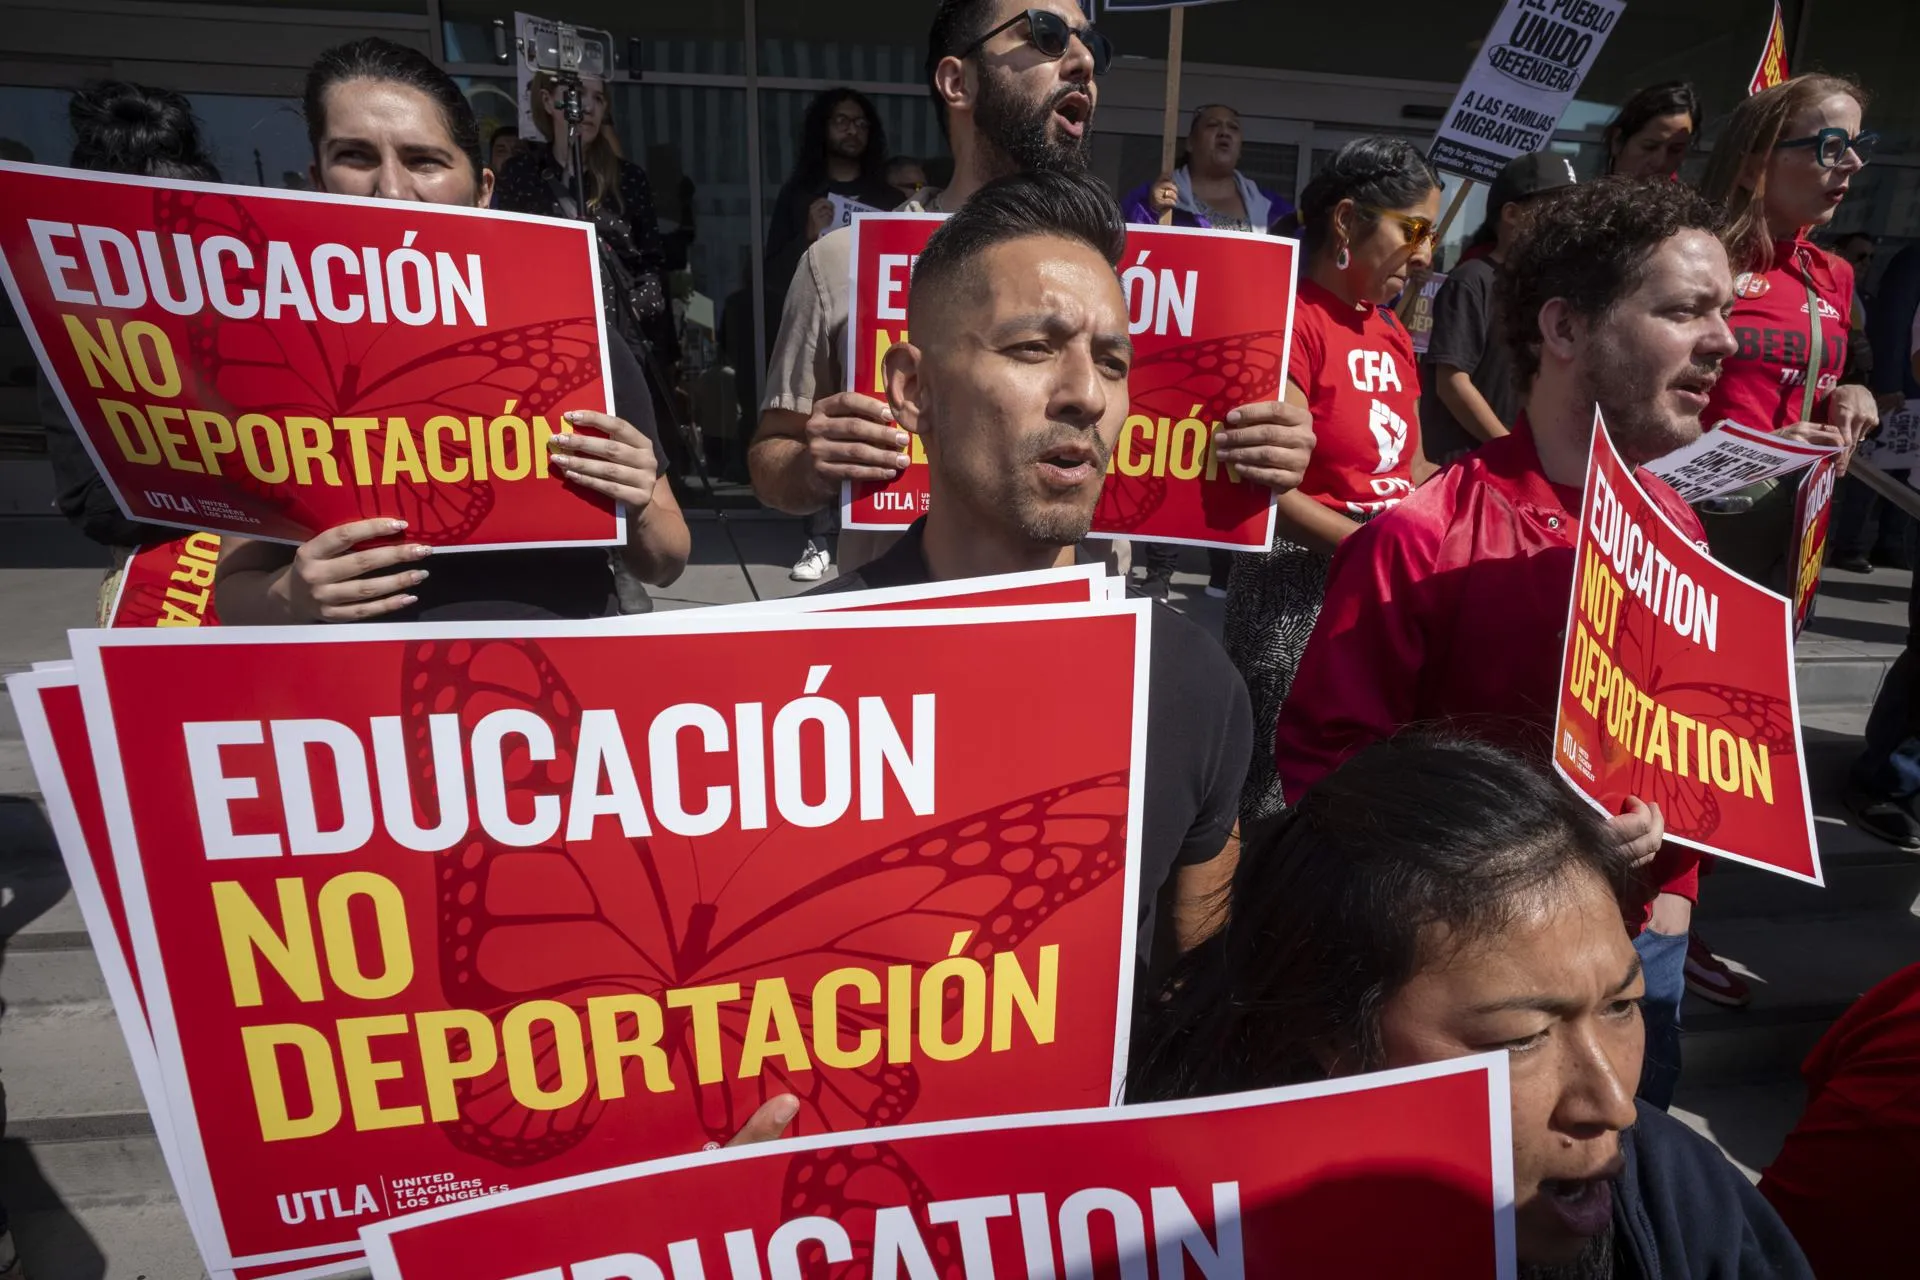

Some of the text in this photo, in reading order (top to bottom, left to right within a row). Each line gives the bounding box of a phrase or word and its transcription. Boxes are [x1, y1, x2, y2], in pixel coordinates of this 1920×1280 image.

[1550, 0, 1616, 34] PUEBLO
[1509, 10, 1593, 68] UNIDO
[1450, 109, 1544, 152] MIGRANTES!
[1461, 90, 1556, 132] A LAS FAMILIAS
[26, 218, 488, 327] EDUCACIÓN
[62, 313, 183, 399] NO
[1347, 348, 1402, 393] CFA
[1690, 450, 1742, 473] COME
[144, 490, 197, 514] UTLA
[199, 499, 230, 509] UNITED
[873, 491, 915, 511] UTLA
[1590, 464, 1719, 652] EDUCATION
[1580, 540, 1624, 649] NOT
[1570, 620, 1774, 805] DEPORTATION
[183, 664, 936, 861] EDUCACIÓN
[1563, 728, 1577, 764] UTLA
[210, 871, 414, 1008] NO
[241, 931, 1060, 1142] DEPORTACIÓN
[392, 1172, 455, 1189] UNITED
[394, 1178, 483, 1200] TEACHERS
[396, 1184, 510, 1210] LOS ANGELES
[276, 1183, 380, 1225] UTLA
[501, 1181, 1246, 1280] ATION
